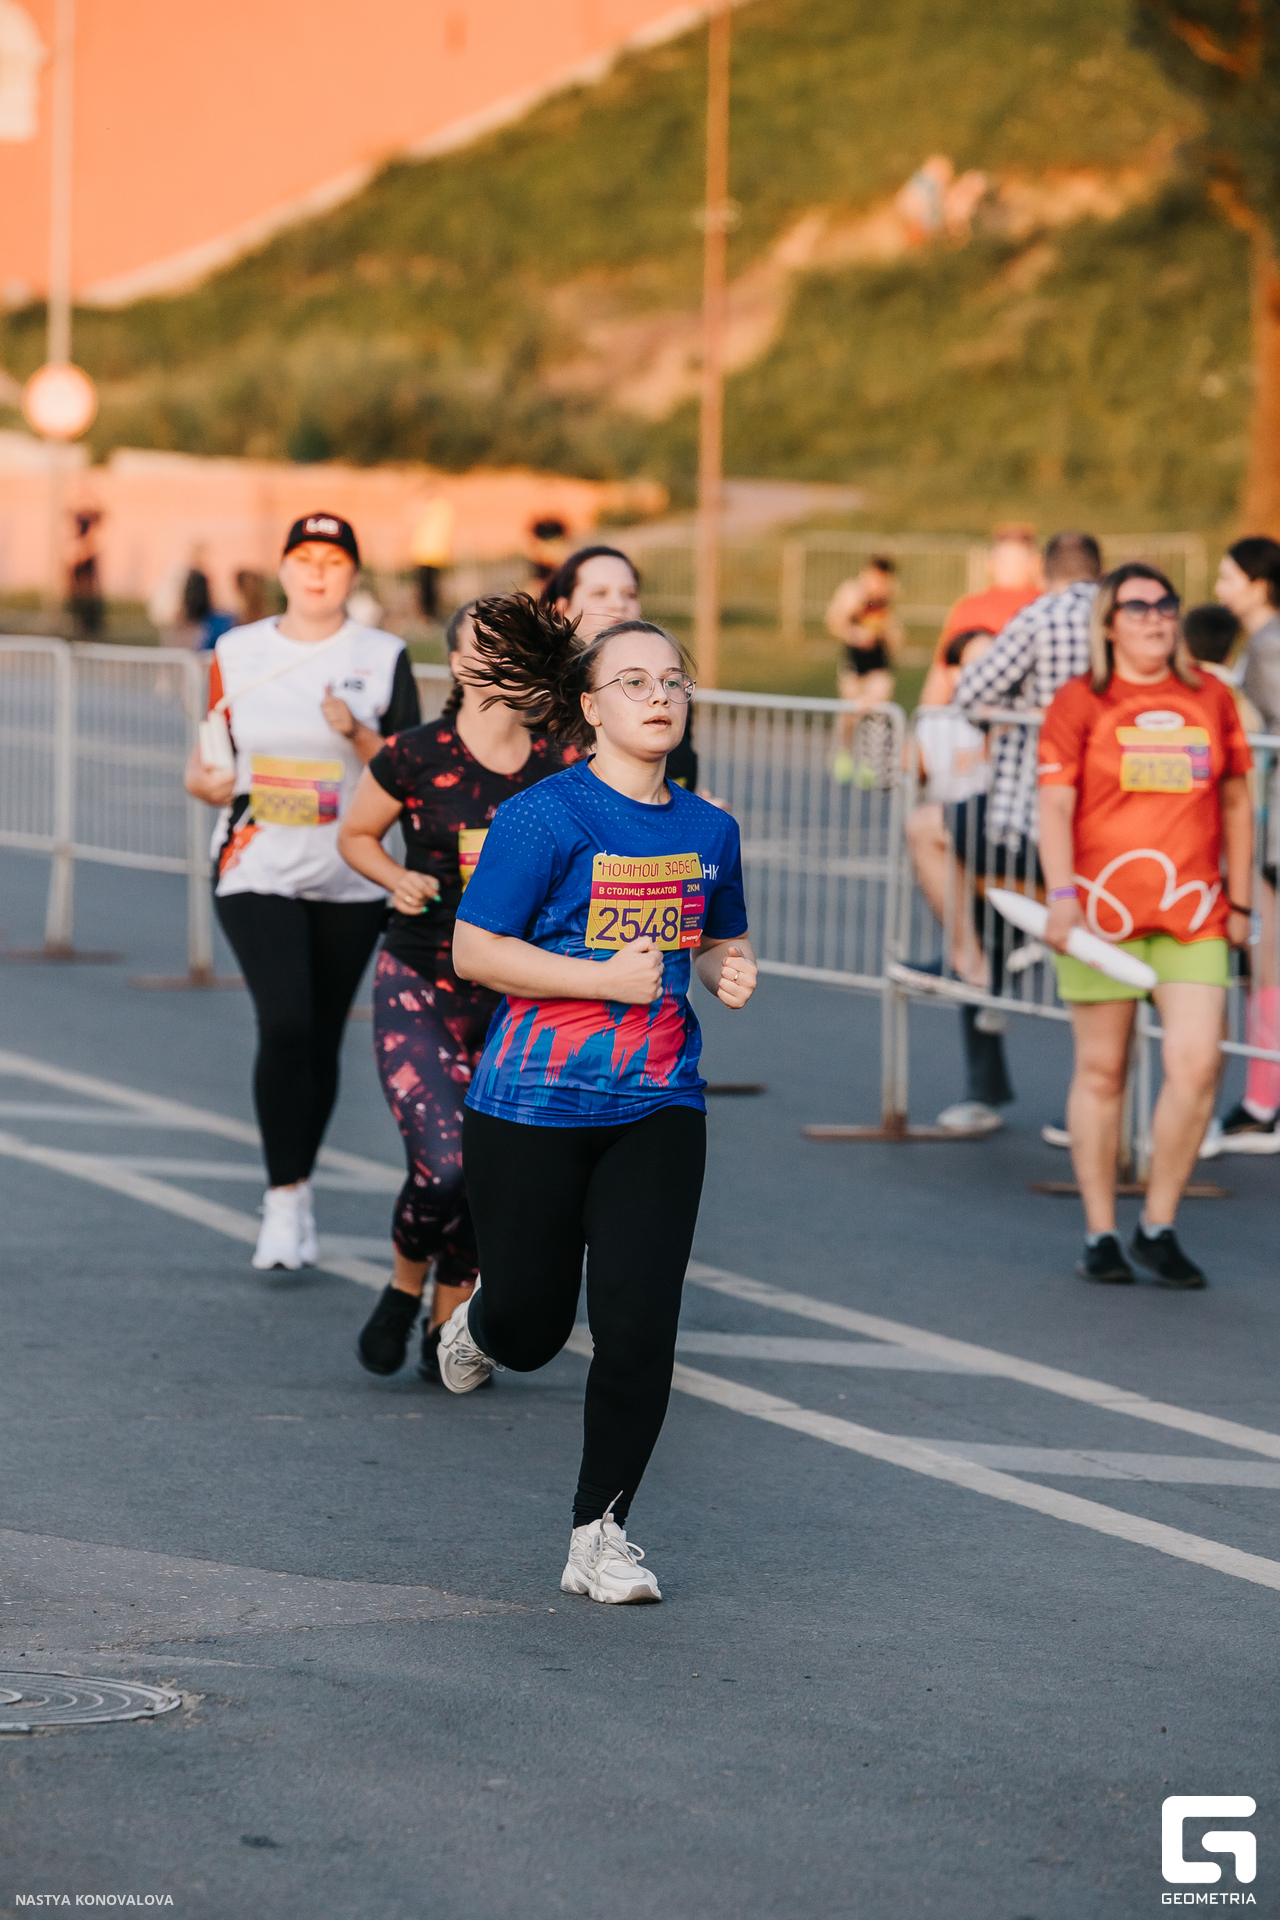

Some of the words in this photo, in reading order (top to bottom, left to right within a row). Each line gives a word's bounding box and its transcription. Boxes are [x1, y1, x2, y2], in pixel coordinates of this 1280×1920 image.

[602, 862, 659, 877] НОЧНОЙ
[665, 860, 695, 876] ЗАБЕГ
[599, 887, 605, 895] В
[607, 887, 645, 897] СТОЛИЦЕ
[646, 886, 677, 896] ЗАКАТОВ
[595, 906, 679, 943] 2548
